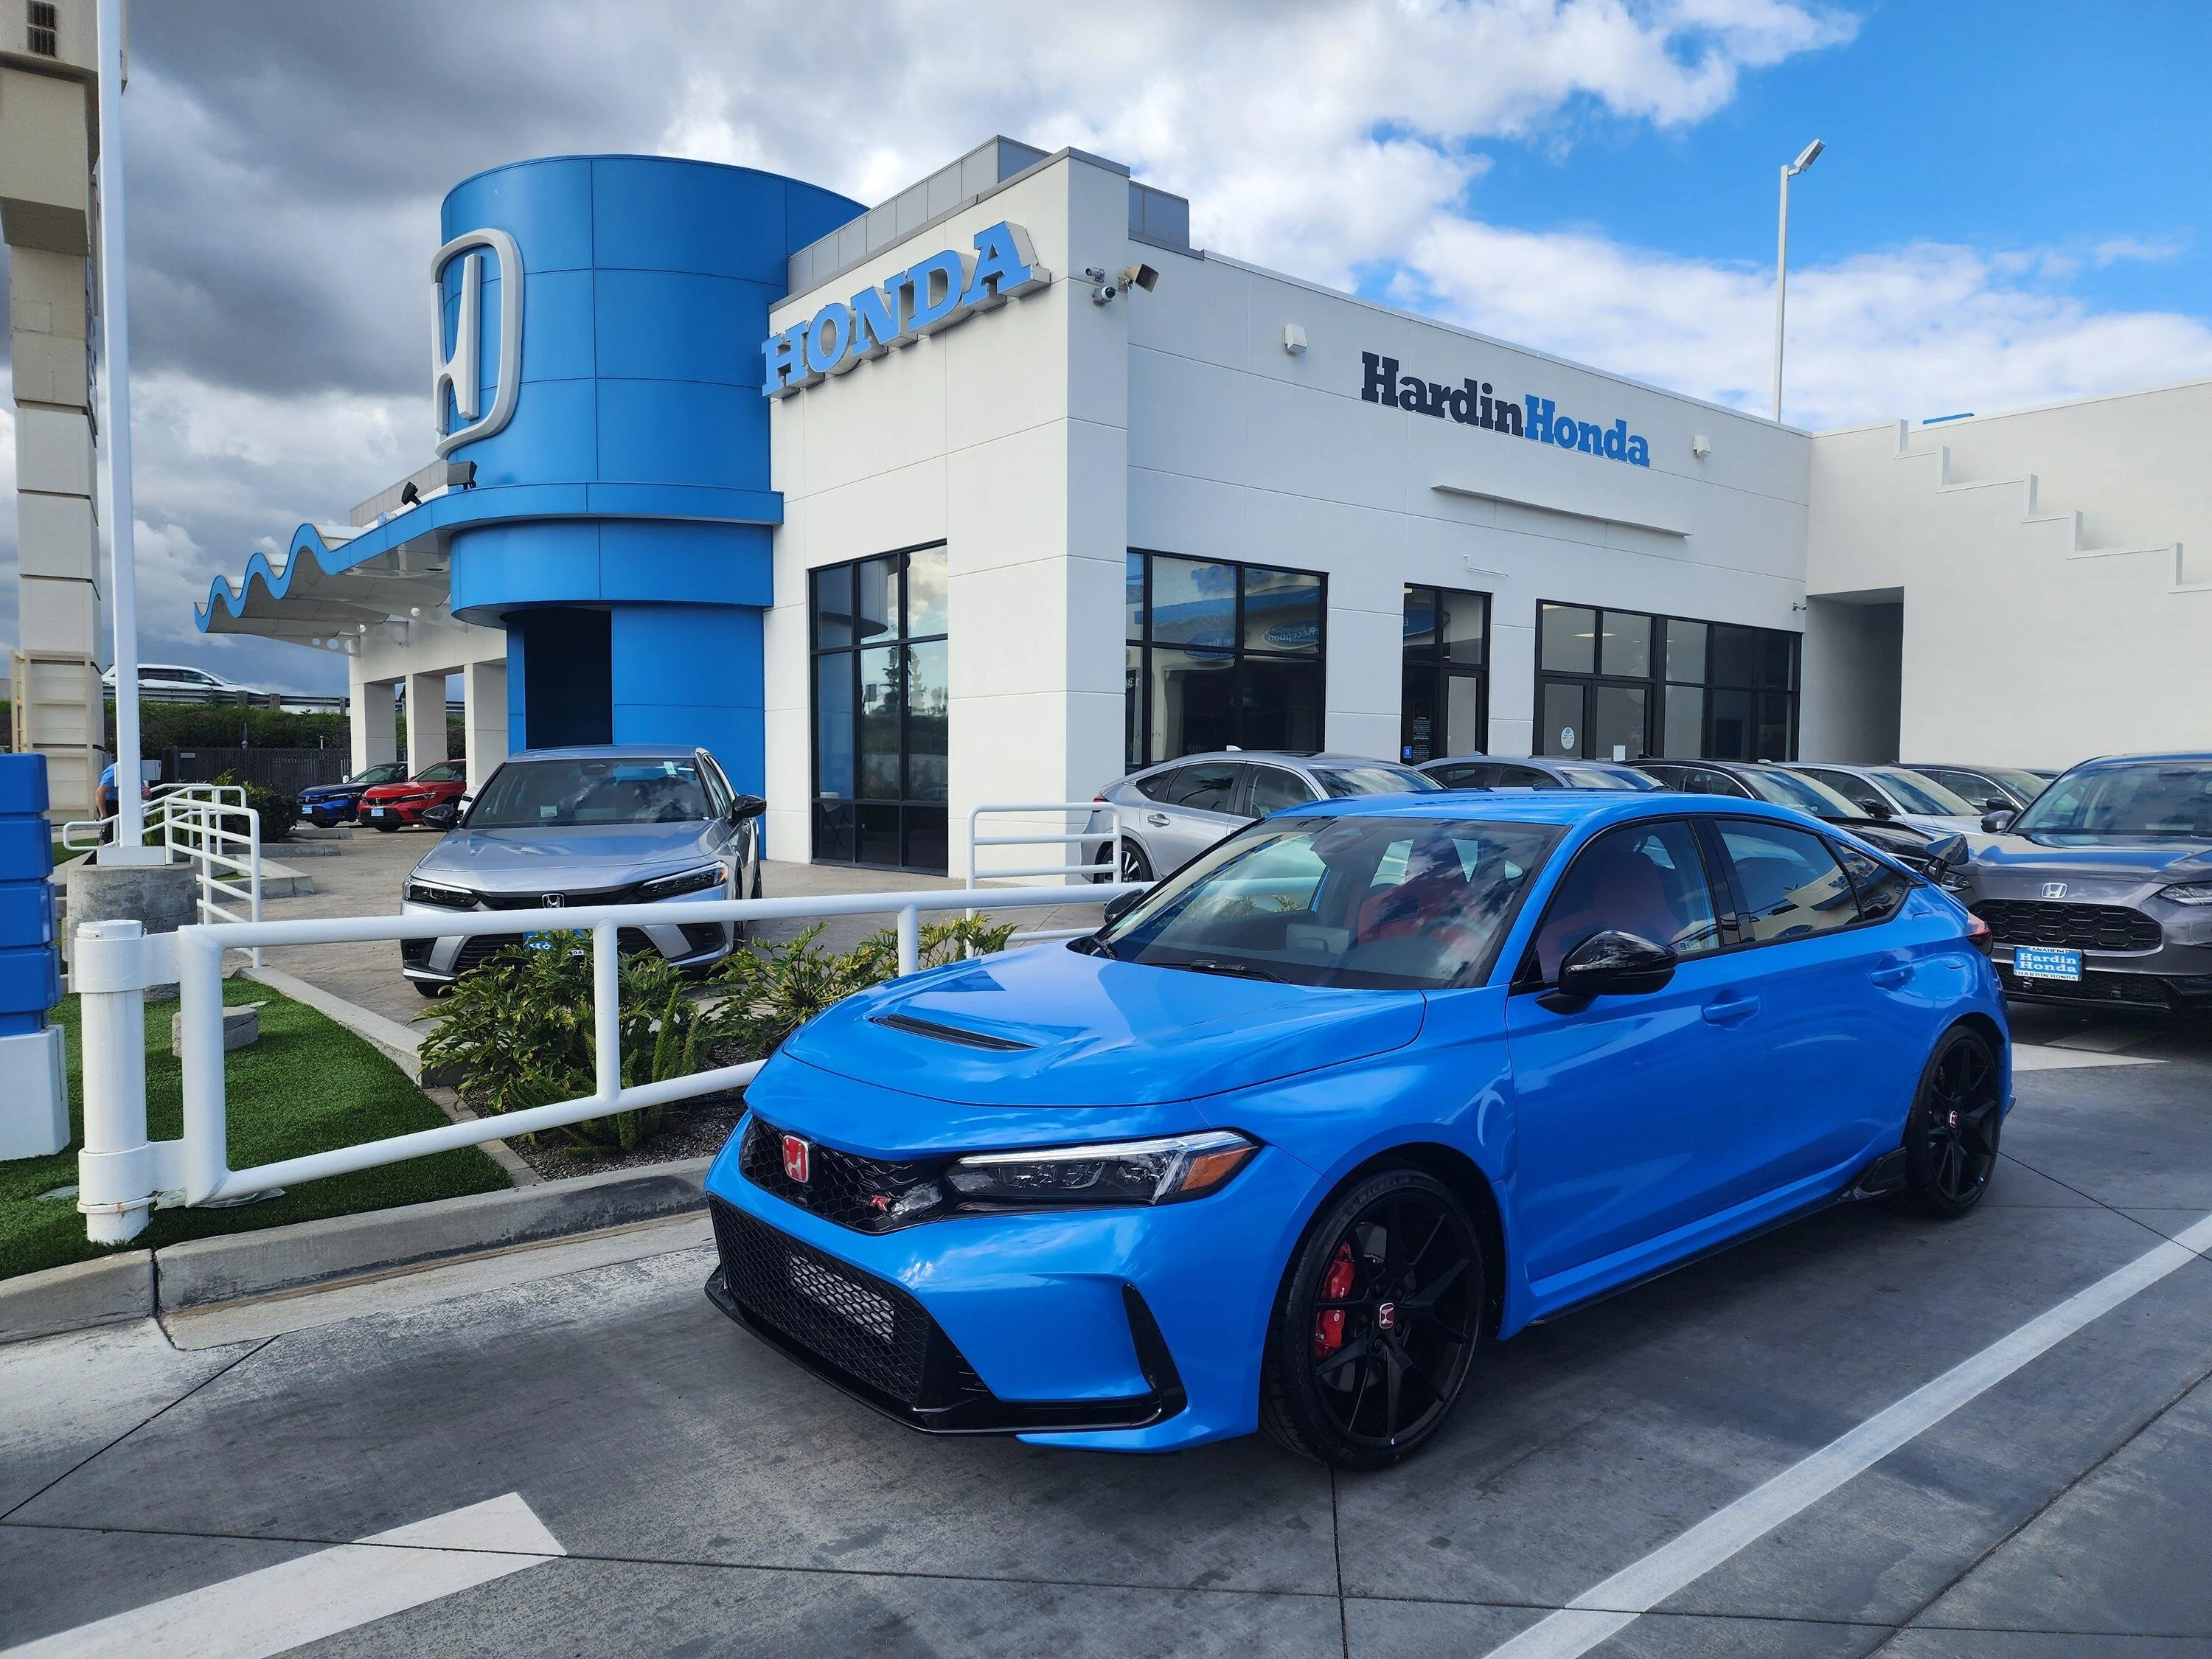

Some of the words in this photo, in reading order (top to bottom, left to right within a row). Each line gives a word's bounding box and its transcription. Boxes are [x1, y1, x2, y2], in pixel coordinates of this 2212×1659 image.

[761, 220, 1034, 397] HONDA
[2020, 953, 2077, 964] Hardin
[2020, 961, 2077, 973] Honda
